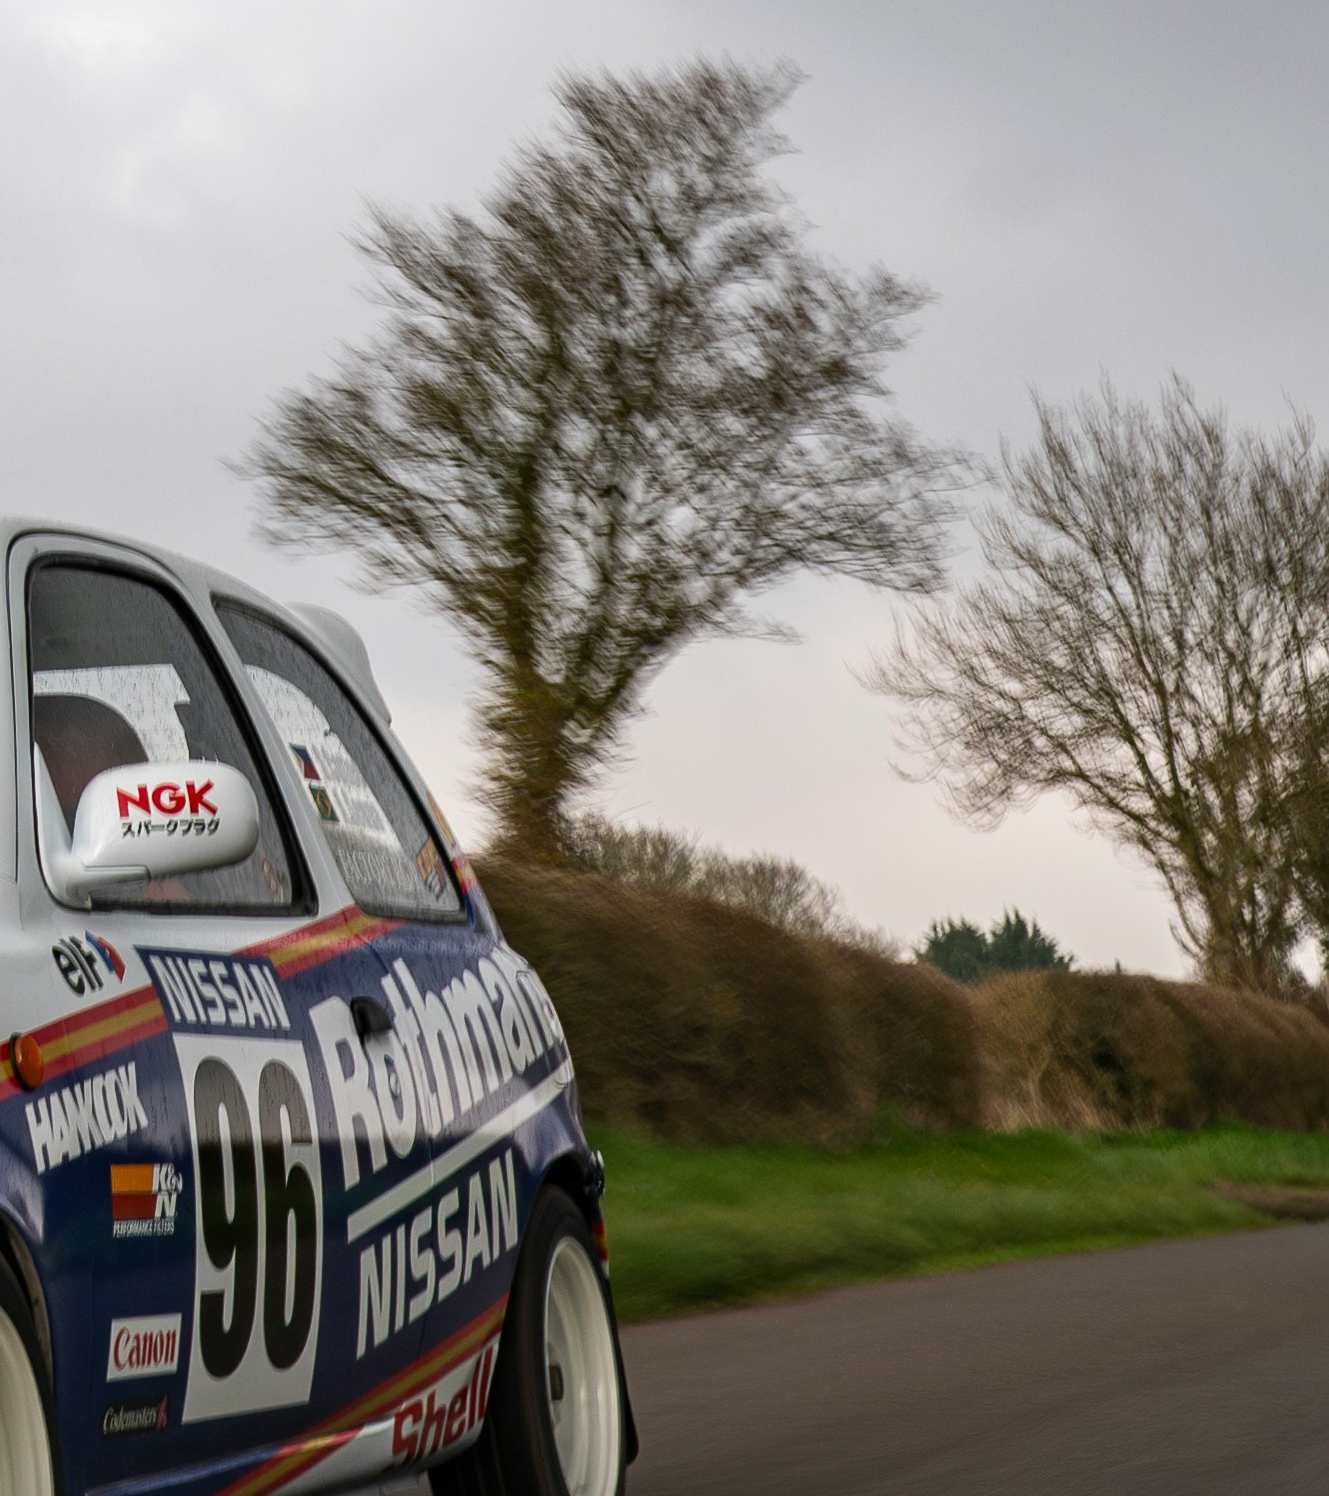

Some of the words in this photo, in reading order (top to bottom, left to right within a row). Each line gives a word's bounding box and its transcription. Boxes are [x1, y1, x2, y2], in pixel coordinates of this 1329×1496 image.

[116, 779, 219, 820] NGK
[51, 935, 105, 997] elf
[149, 954, 291, 1030] NISSAN
[25, 1061, 148, 1175] HANKOOK
[193, 1055, 315, 1378] 96
[356, 1147, 519, 1361] NISSAN
[113, 1326, 177, 1371] Canon
[392, 1345, 494, 1467] Shell
